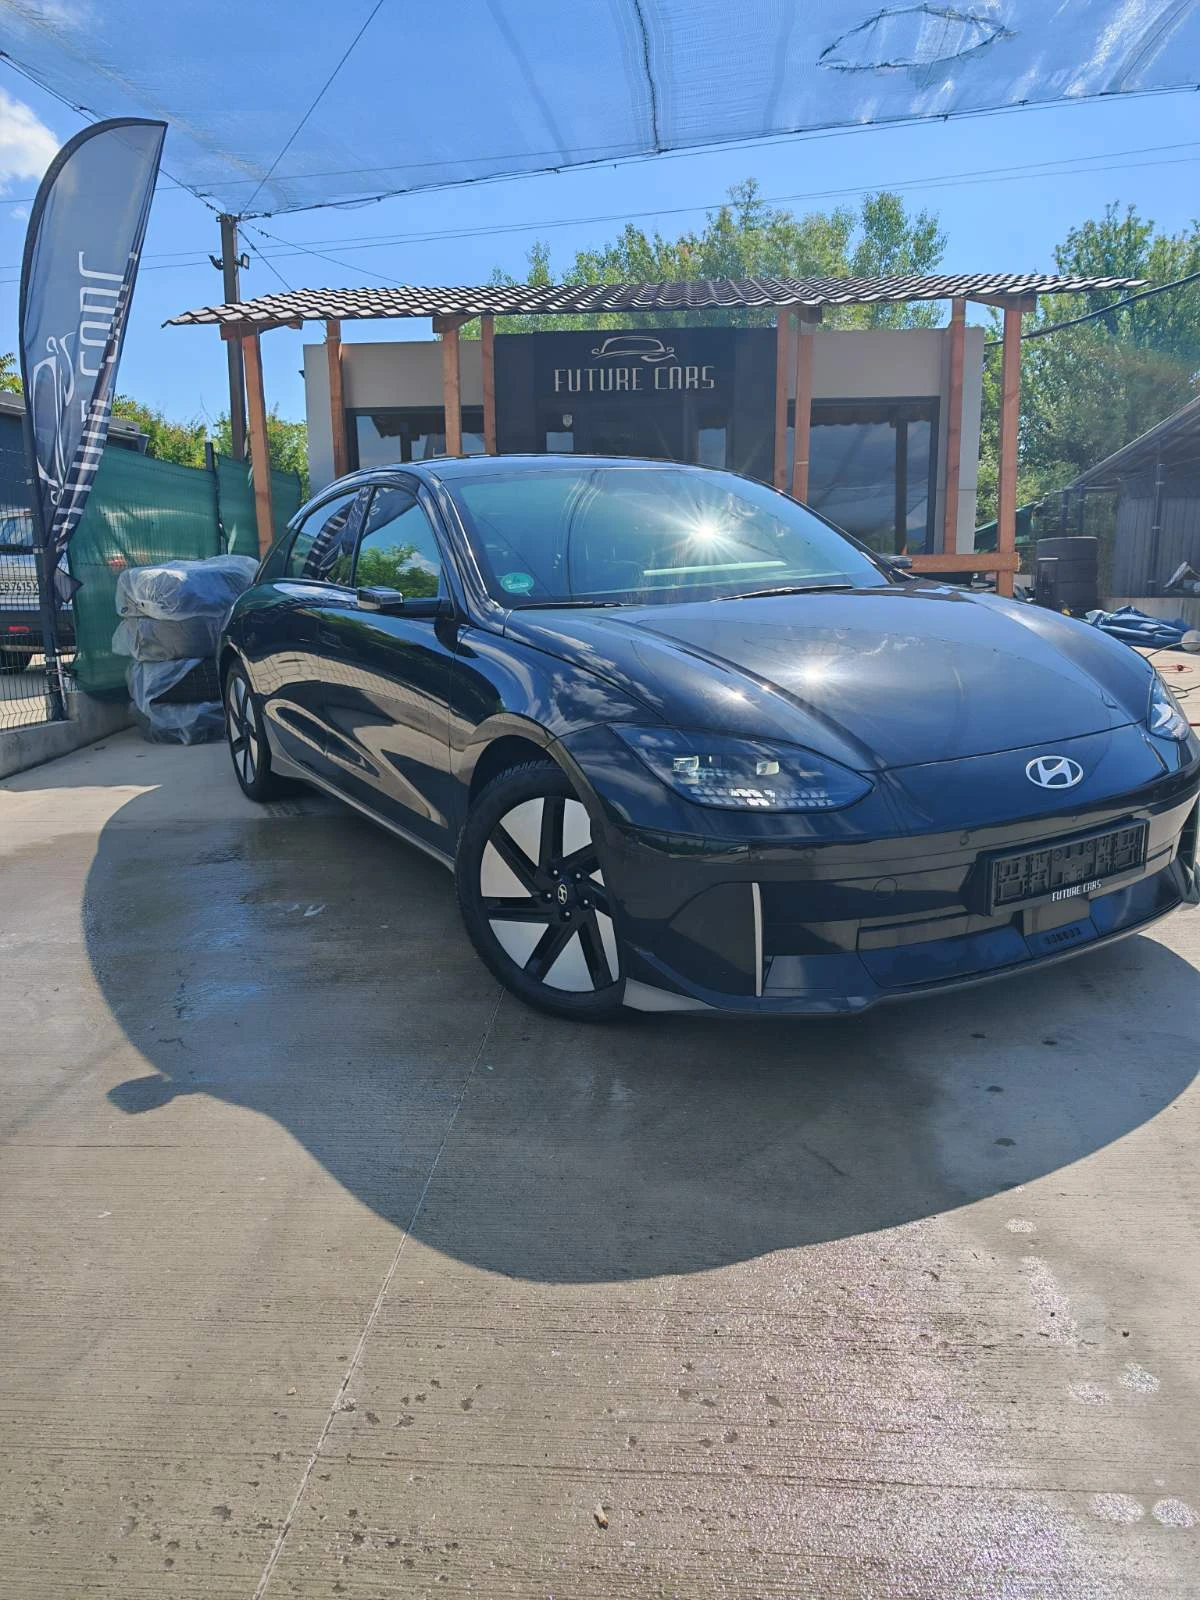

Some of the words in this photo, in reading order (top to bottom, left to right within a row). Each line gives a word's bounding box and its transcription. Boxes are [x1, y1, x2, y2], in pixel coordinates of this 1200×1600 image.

[554, 367, 644, 392] FUTURE
[654, 365, 716, 390] CARS
[1052, 885, 1081, 902] FUTURE
[1083, 879, 1102, 893] CARS
